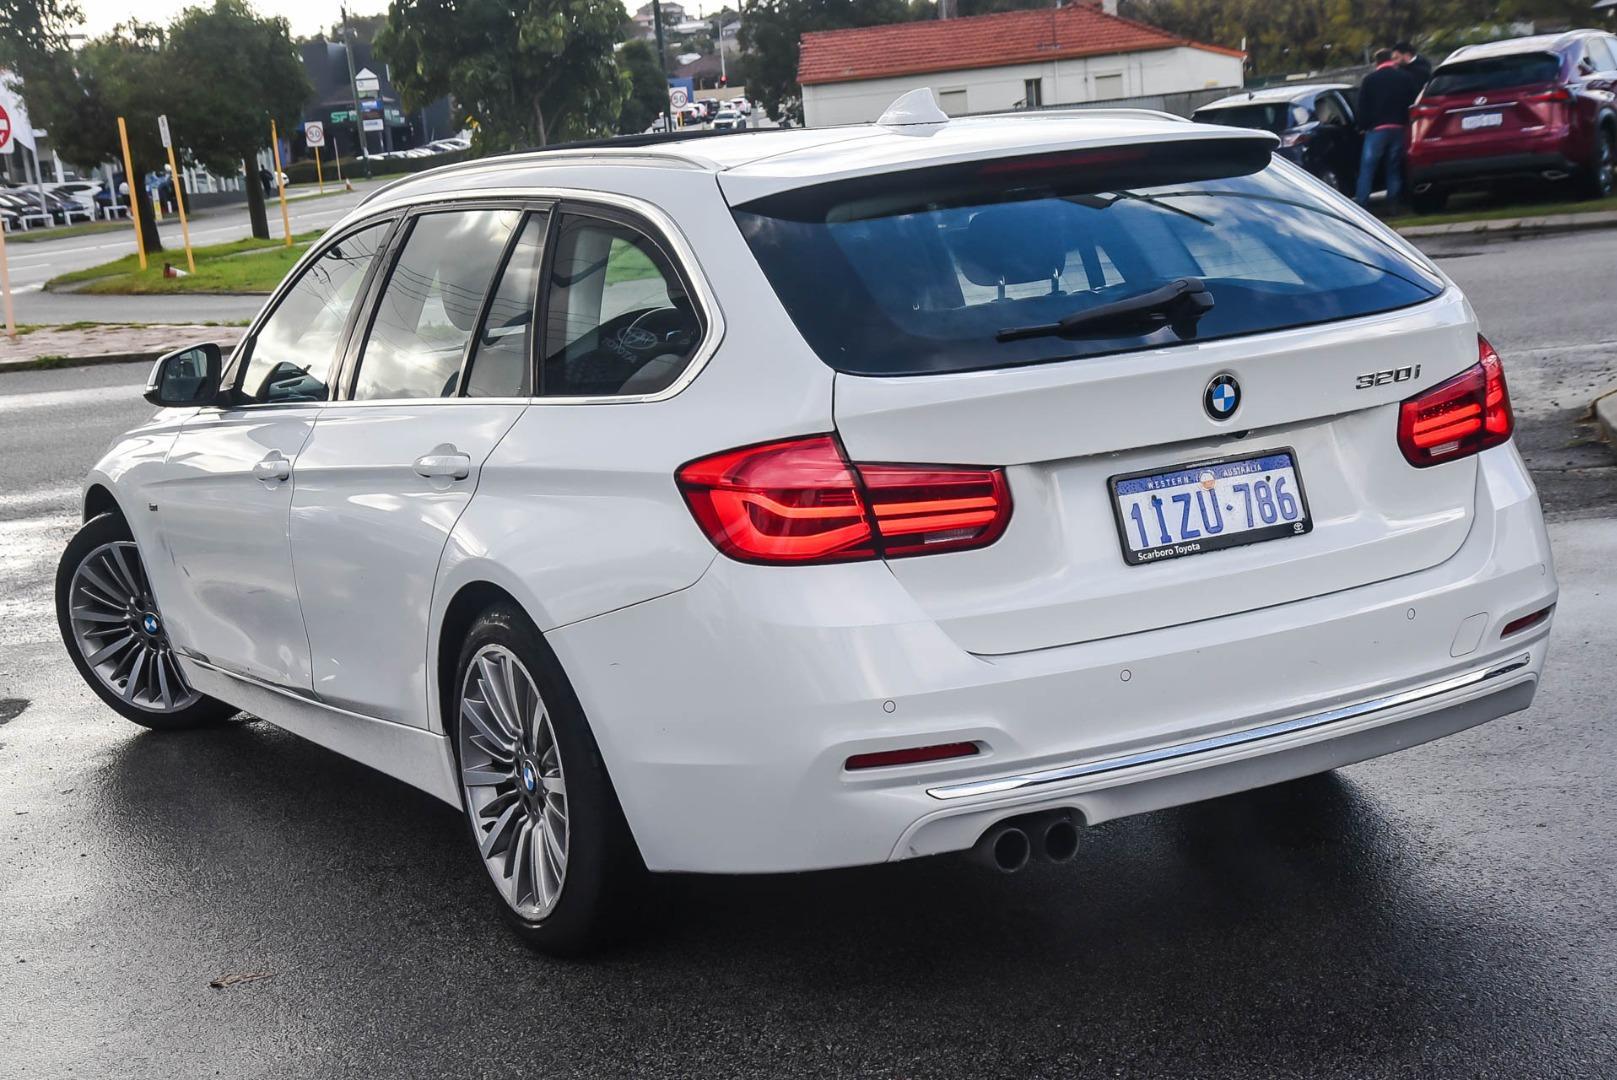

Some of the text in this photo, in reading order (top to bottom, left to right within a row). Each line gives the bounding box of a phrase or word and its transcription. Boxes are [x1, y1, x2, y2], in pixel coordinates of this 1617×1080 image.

[1355, 364, 1421, 390] 320i
[1149, 475, 1189, 489] WESTERN
[1222, 463, 1262, 477] AUSTRALIA
[1138, 542, 1201, 561] Scarboro Toyota
